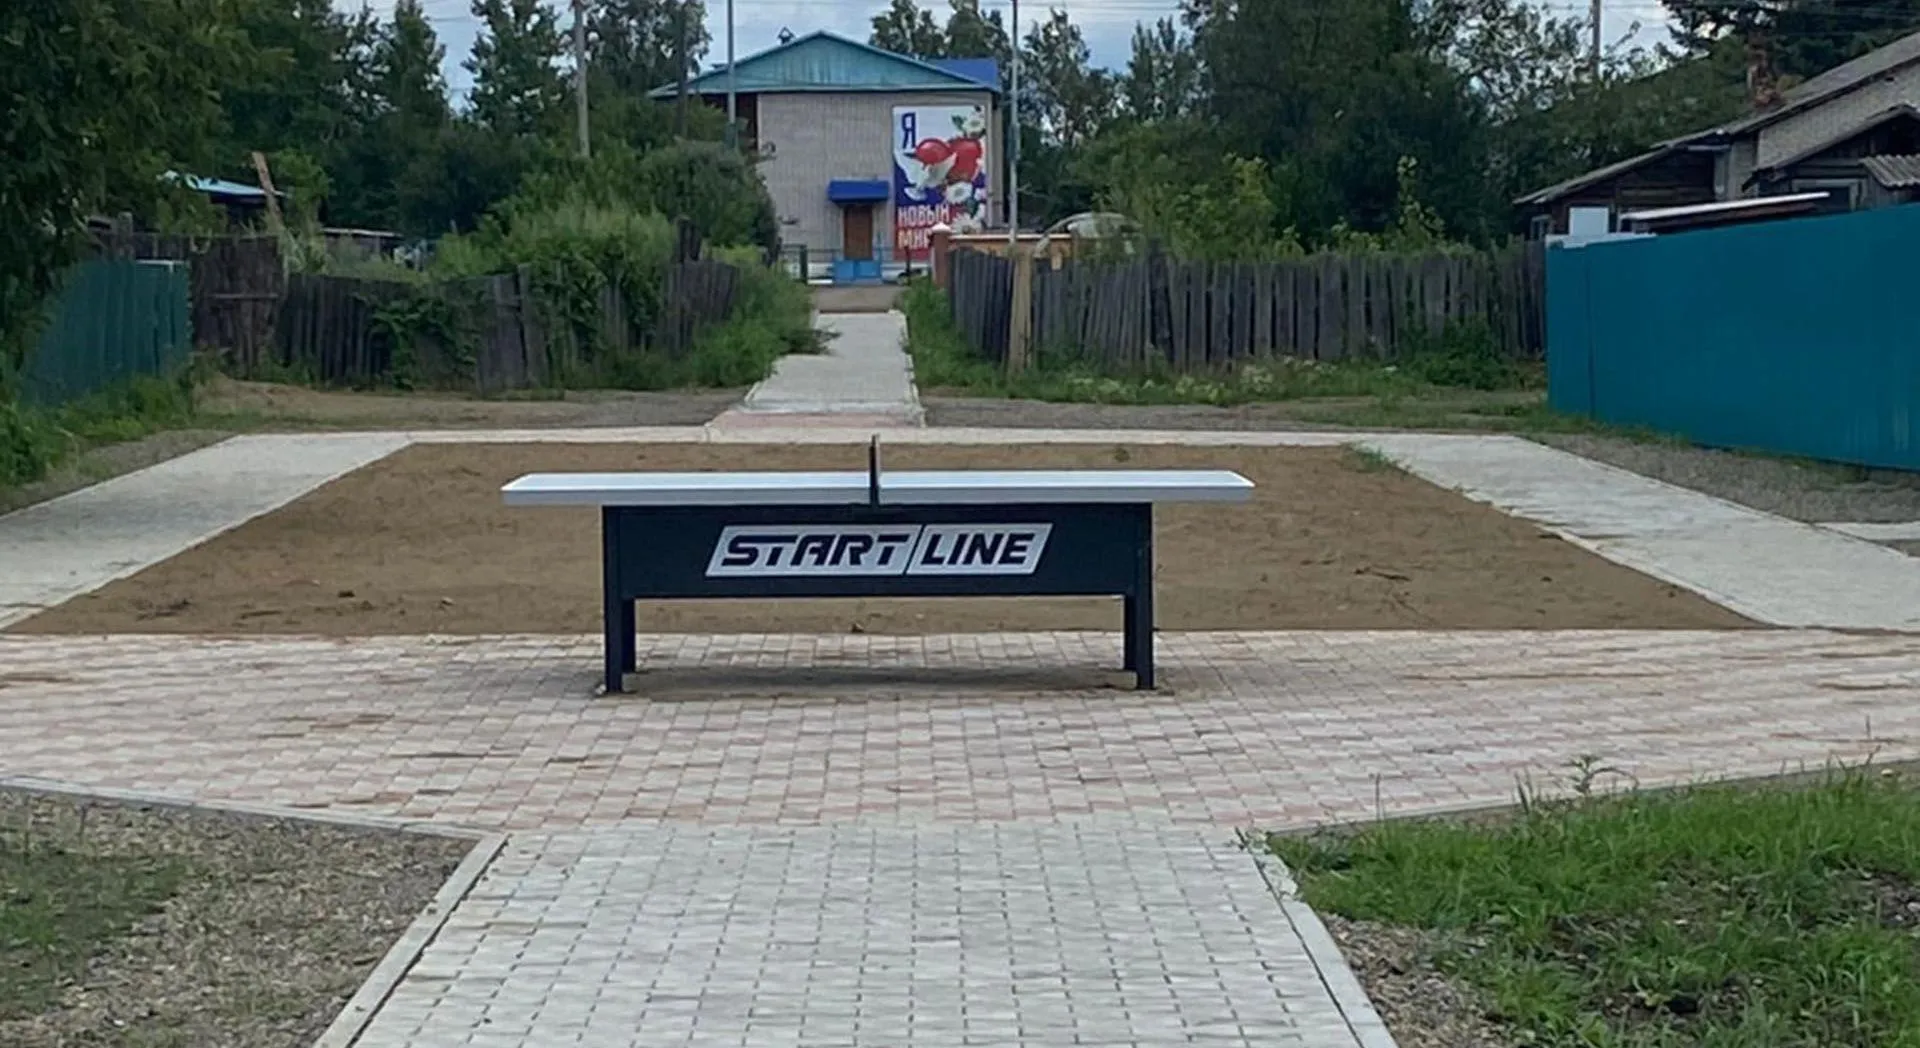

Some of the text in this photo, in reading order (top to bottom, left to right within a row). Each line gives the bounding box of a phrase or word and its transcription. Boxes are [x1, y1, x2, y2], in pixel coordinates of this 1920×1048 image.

[902, 112, 916, 149] Я
[721, 533, 1036, 567] START LINE
